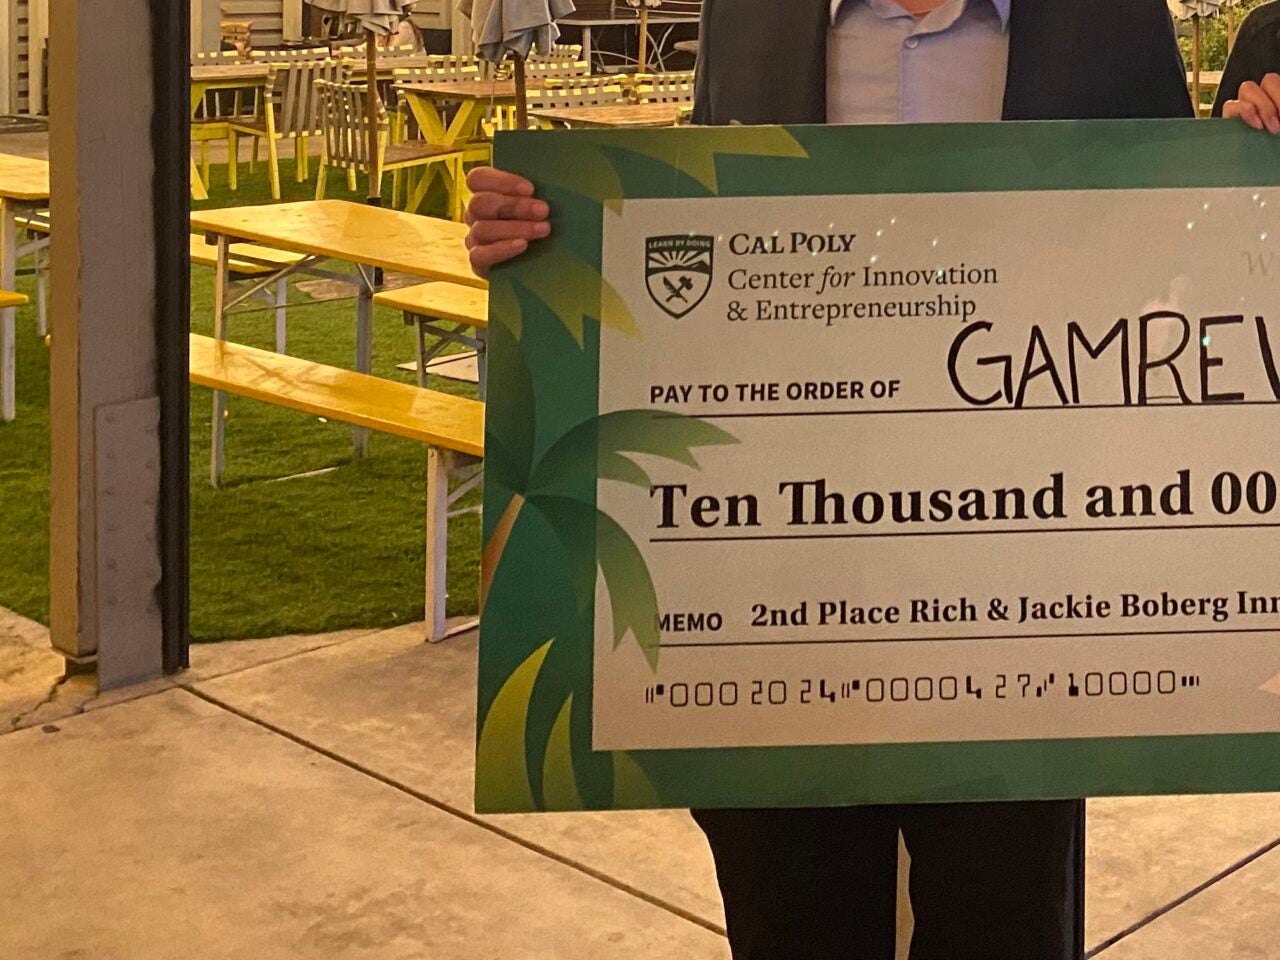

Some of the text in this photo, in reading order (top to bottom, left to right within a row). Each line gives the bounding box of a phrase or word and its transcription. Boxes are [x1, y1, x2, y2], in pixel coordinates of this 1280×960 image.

[727, 262, 998, 294] Center for Innovation
[726, 294, 977, 326] & Entrepreneurship
[650, 379, 901, 404] PAY TO THE ORDER OF
[649, 483, 762, 529] Ten
[778, 471, 1068, 526] Thousand
[1085, 468, 1194, 518] and
[655, 612, 724, 634] MEMO
[751, 601, 809, 627] 2nd
[817, 600, 900, 626] Place
[909, 597, 978, 623] Rich
[987, 598, 1009, 621] &
[1017, 594, 1111, 624] Jackie
[1120, 591, 1229, 623] Boberg
